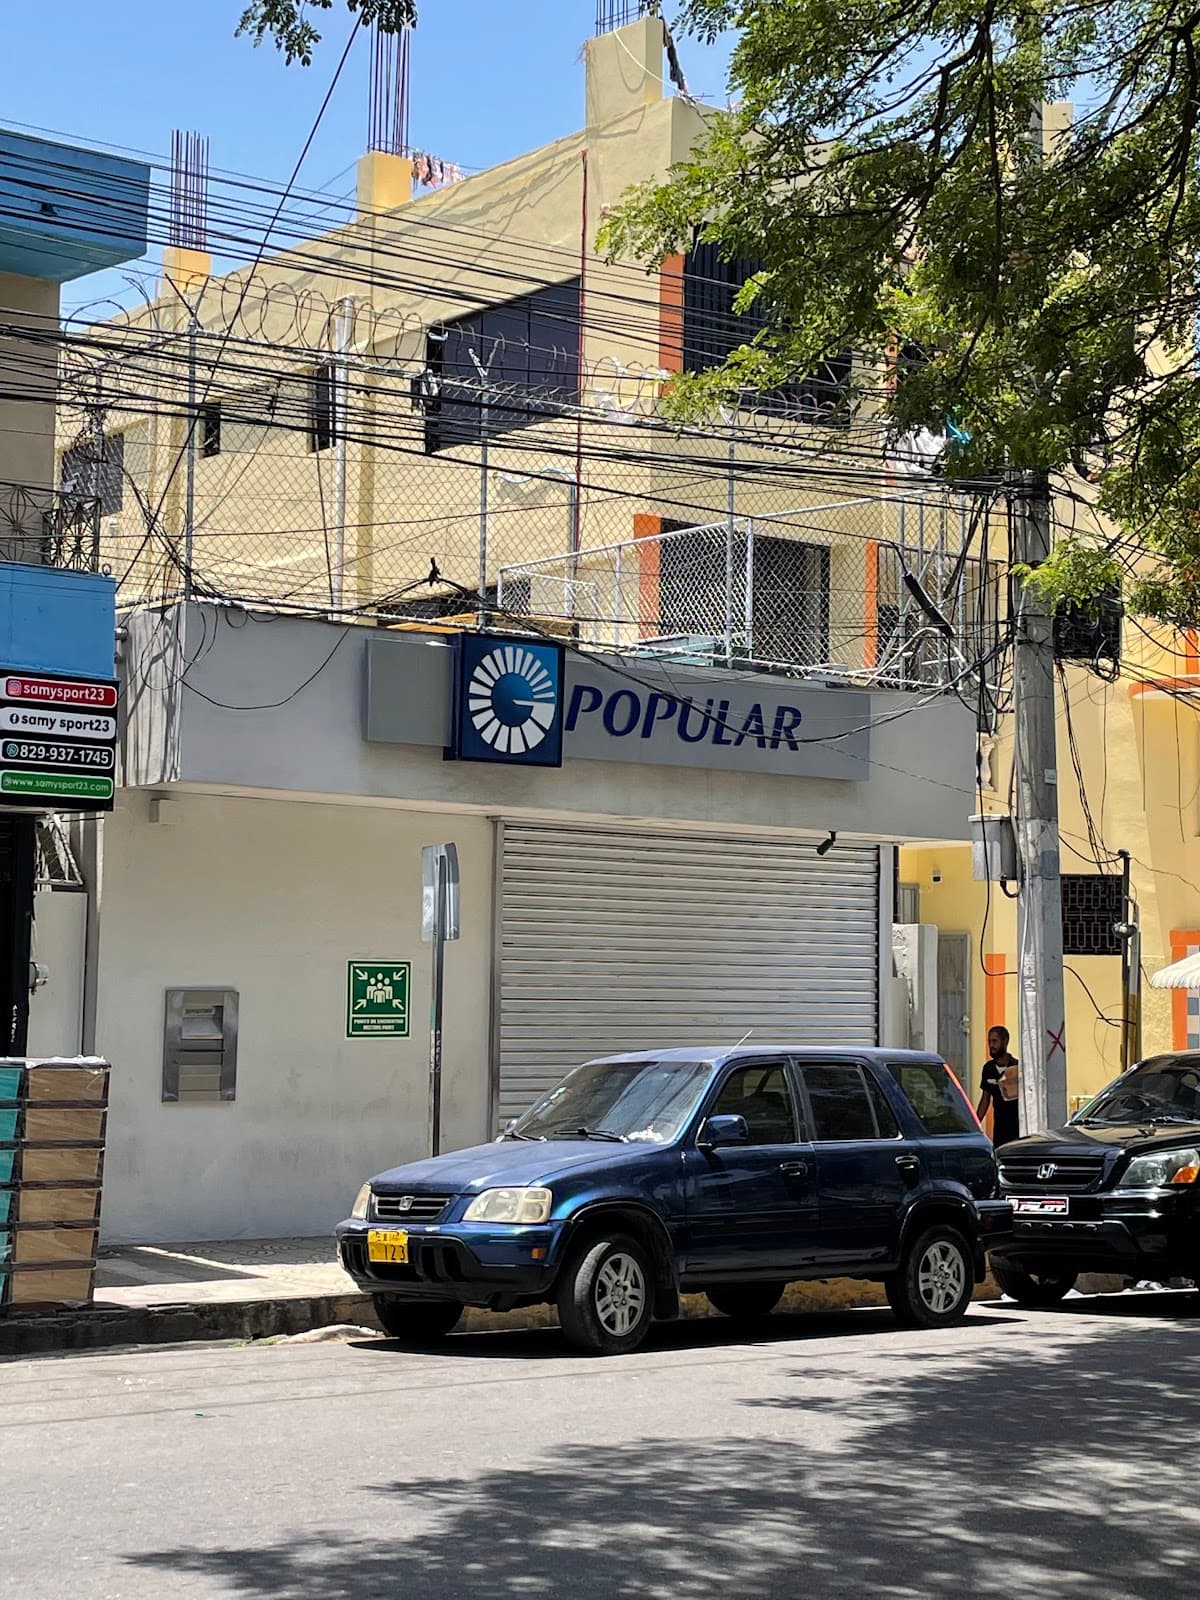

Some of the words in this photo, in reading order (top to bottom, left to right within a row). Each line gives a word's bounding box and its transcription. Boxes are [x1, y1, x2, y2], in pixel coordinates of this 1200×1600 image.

[23, 684, 105, 701] samysport23
[21, 715, 56, 730] samy
[59, 719, 110, 732] sport23
[564, 684, 802, 751] POPULAR
[20, 744, 109, 764] 829-937-1745
[12, 778, 109, 792] www.samysport23.com
